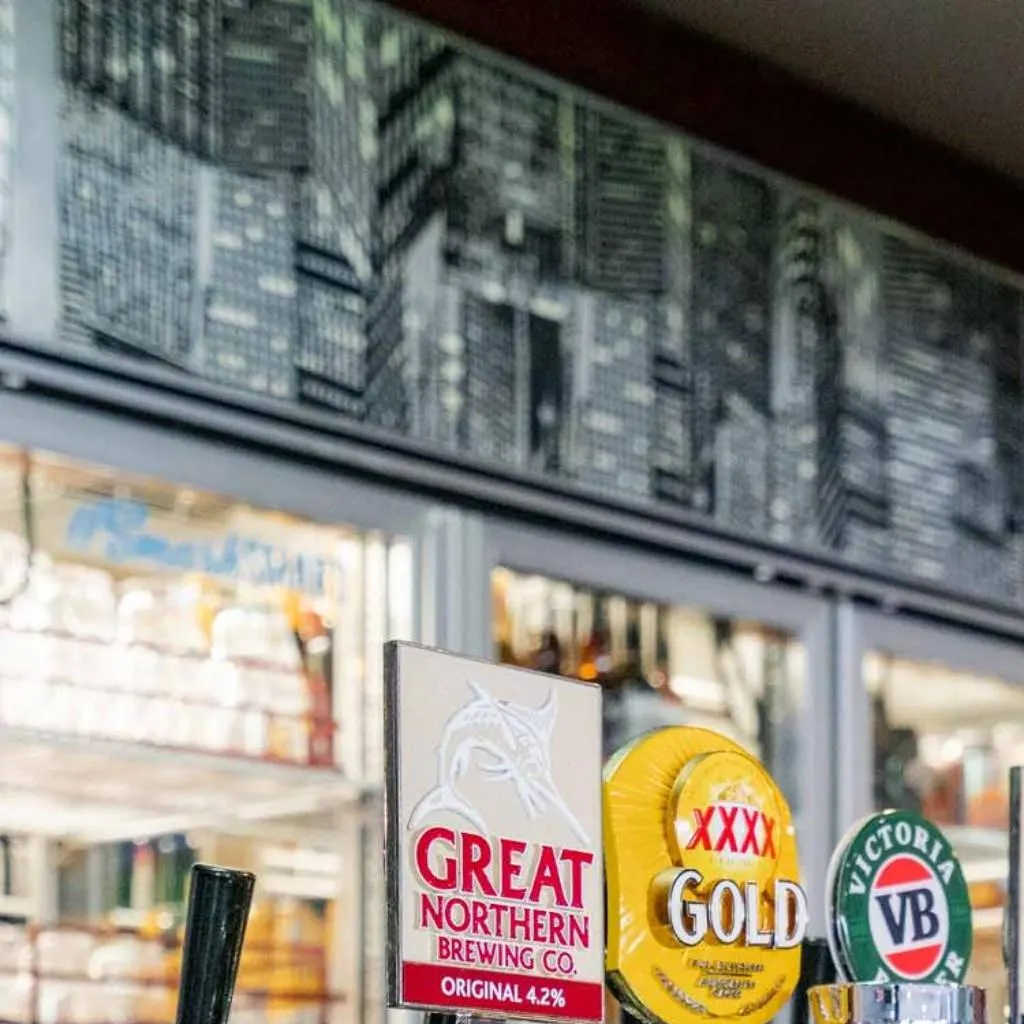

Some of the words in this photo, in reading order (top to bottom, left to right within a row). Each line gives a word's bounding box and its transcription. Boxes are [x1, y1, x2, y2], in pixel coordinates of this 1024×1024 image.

[685, 806, 776, 859] XXXX
[848, 821, 956, 896] VICTORIA
[415, 826, 594, 909] GREAT
[420, 892, 591, 949] NORTHERN
[667, 868, 809, 950] GOLD
[875, 888, 939, 945] VB
[437, 935, 535, 970] BREWING
[543, 949, 578, 975] CO.
[440, 975, 523, 1004] ORIGINAL
[526, 984, 566, 1008] 4.2%
